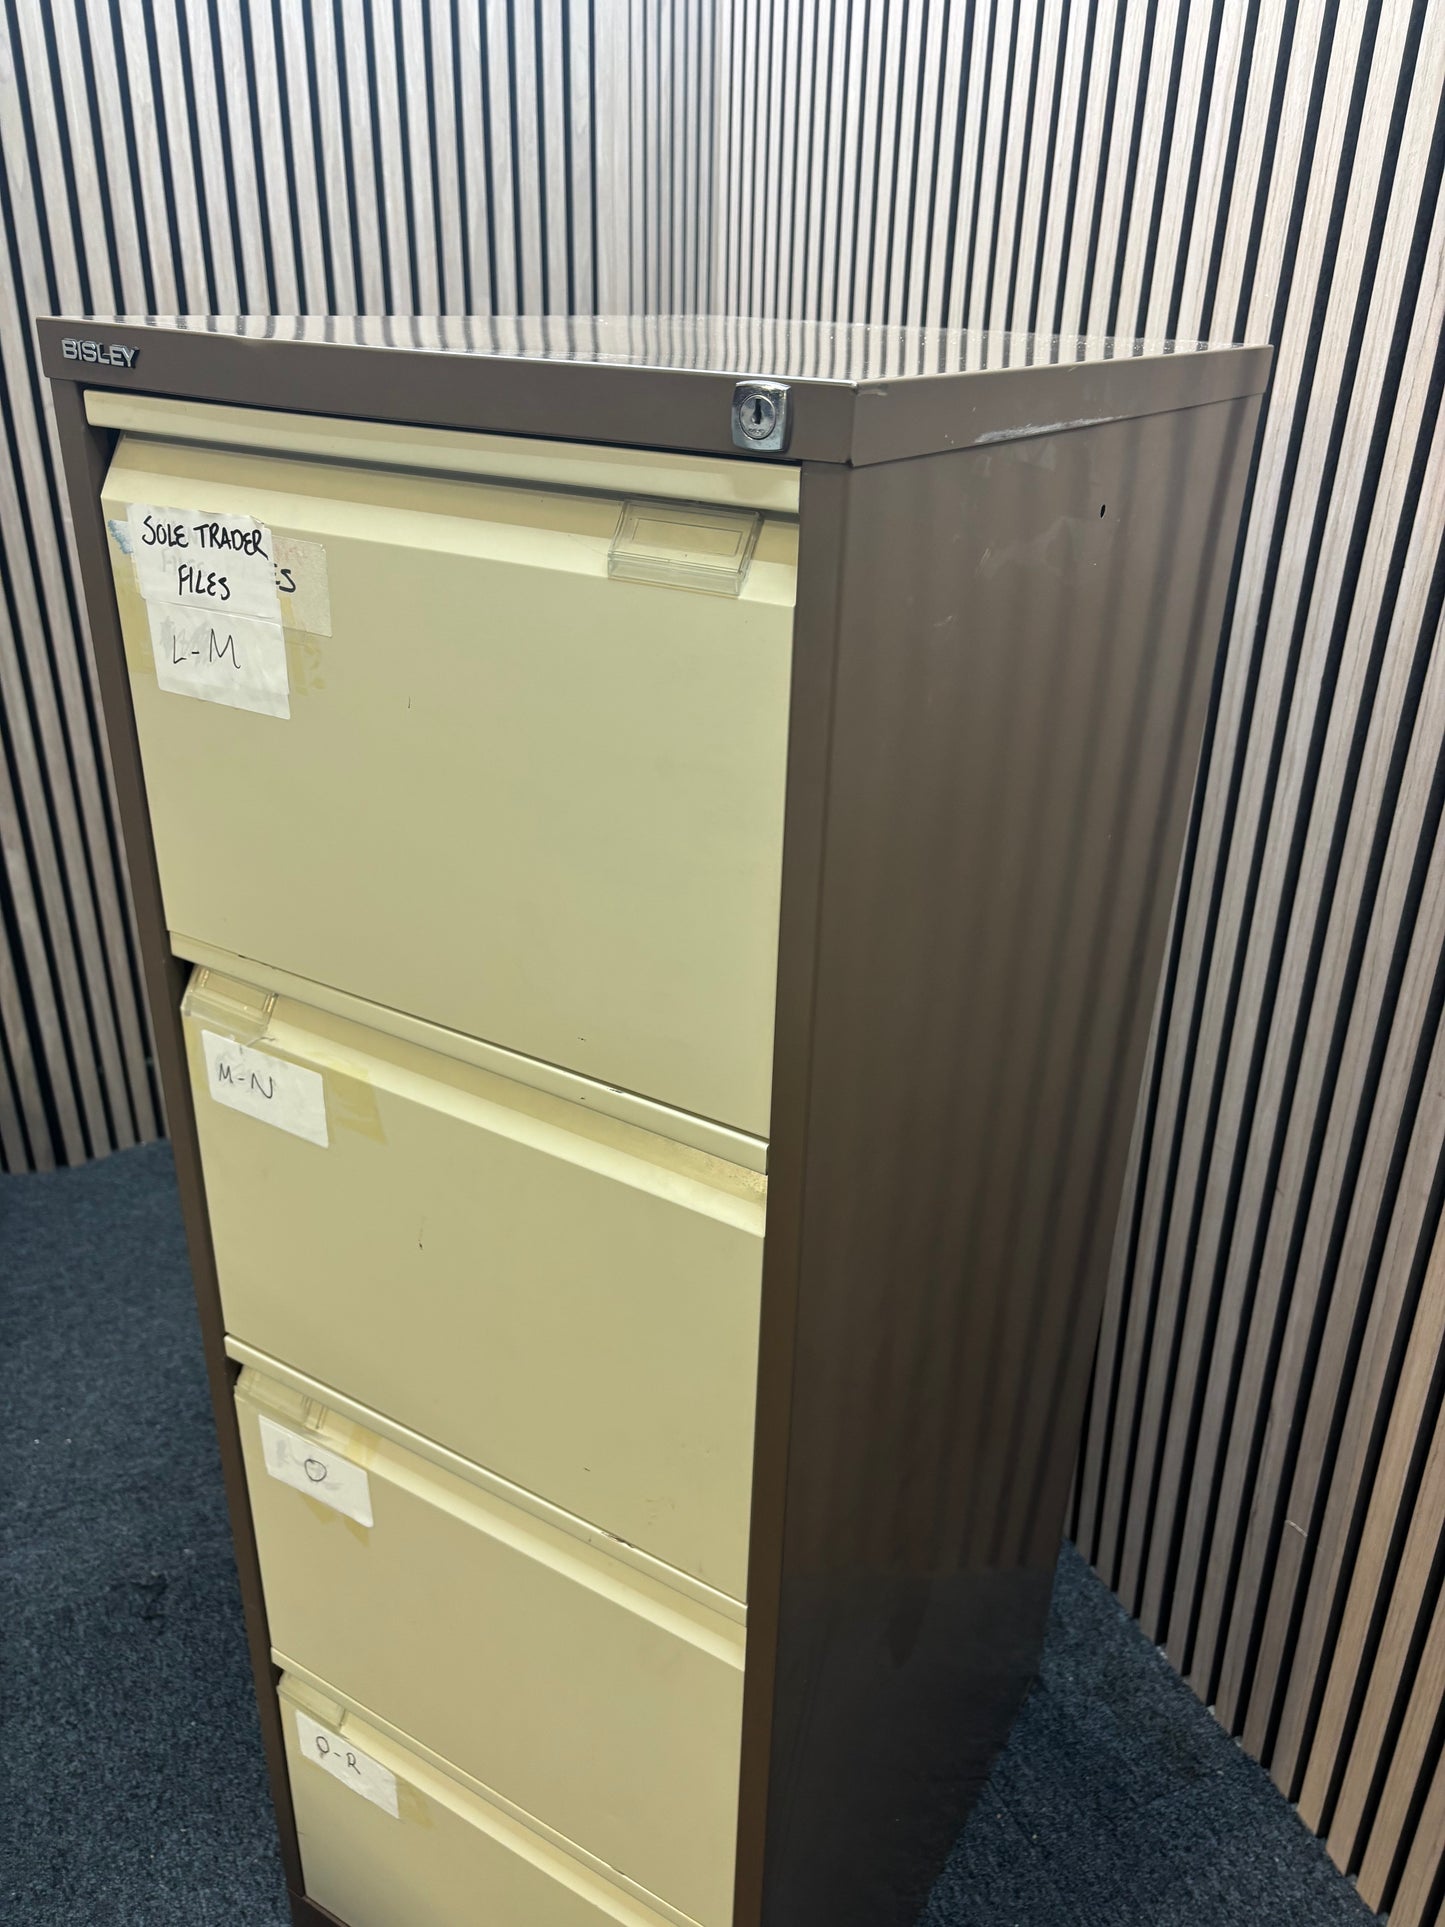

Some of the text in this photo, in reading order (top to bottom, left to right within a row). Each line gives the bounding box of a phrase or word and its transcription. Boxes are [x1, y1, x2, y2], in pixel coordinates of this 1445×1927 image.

[61, 337, 138, 368] BISLEY
[142, 515, 269, 560] SOLE TRADER
[178, 563, 231, 600] FILES
